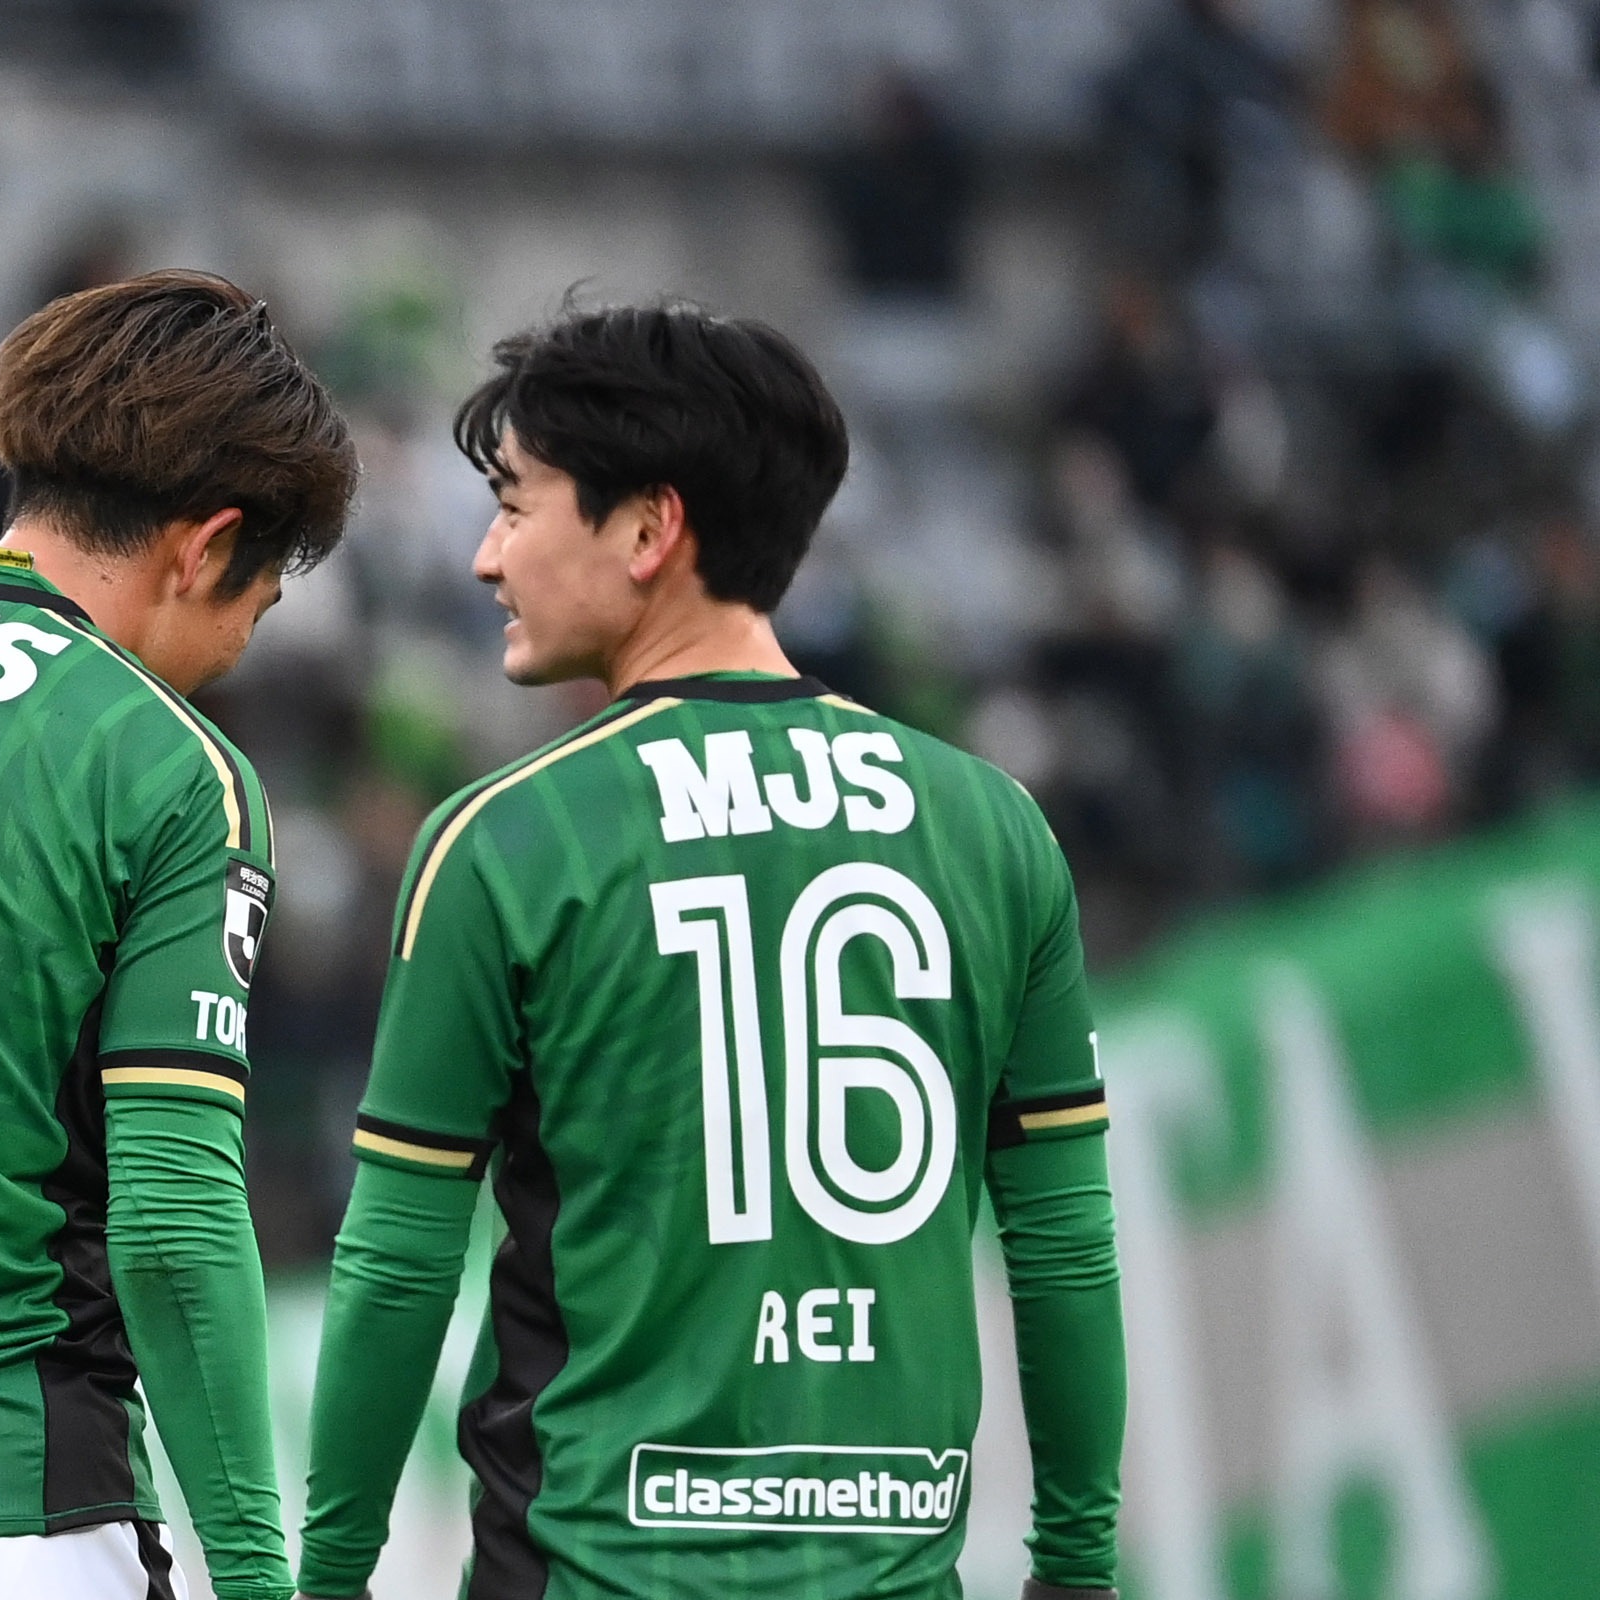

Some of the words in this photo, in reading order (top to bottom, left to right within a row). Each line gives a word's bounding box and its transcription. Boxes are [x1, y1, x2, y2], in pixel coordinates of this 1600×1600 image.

[637, 728, 916, 843] MJS
[648, 862, 957, 1245] 16
[754, 1288, 875, 1364] REI
[644, 1469, 955, 1519] classmethod
